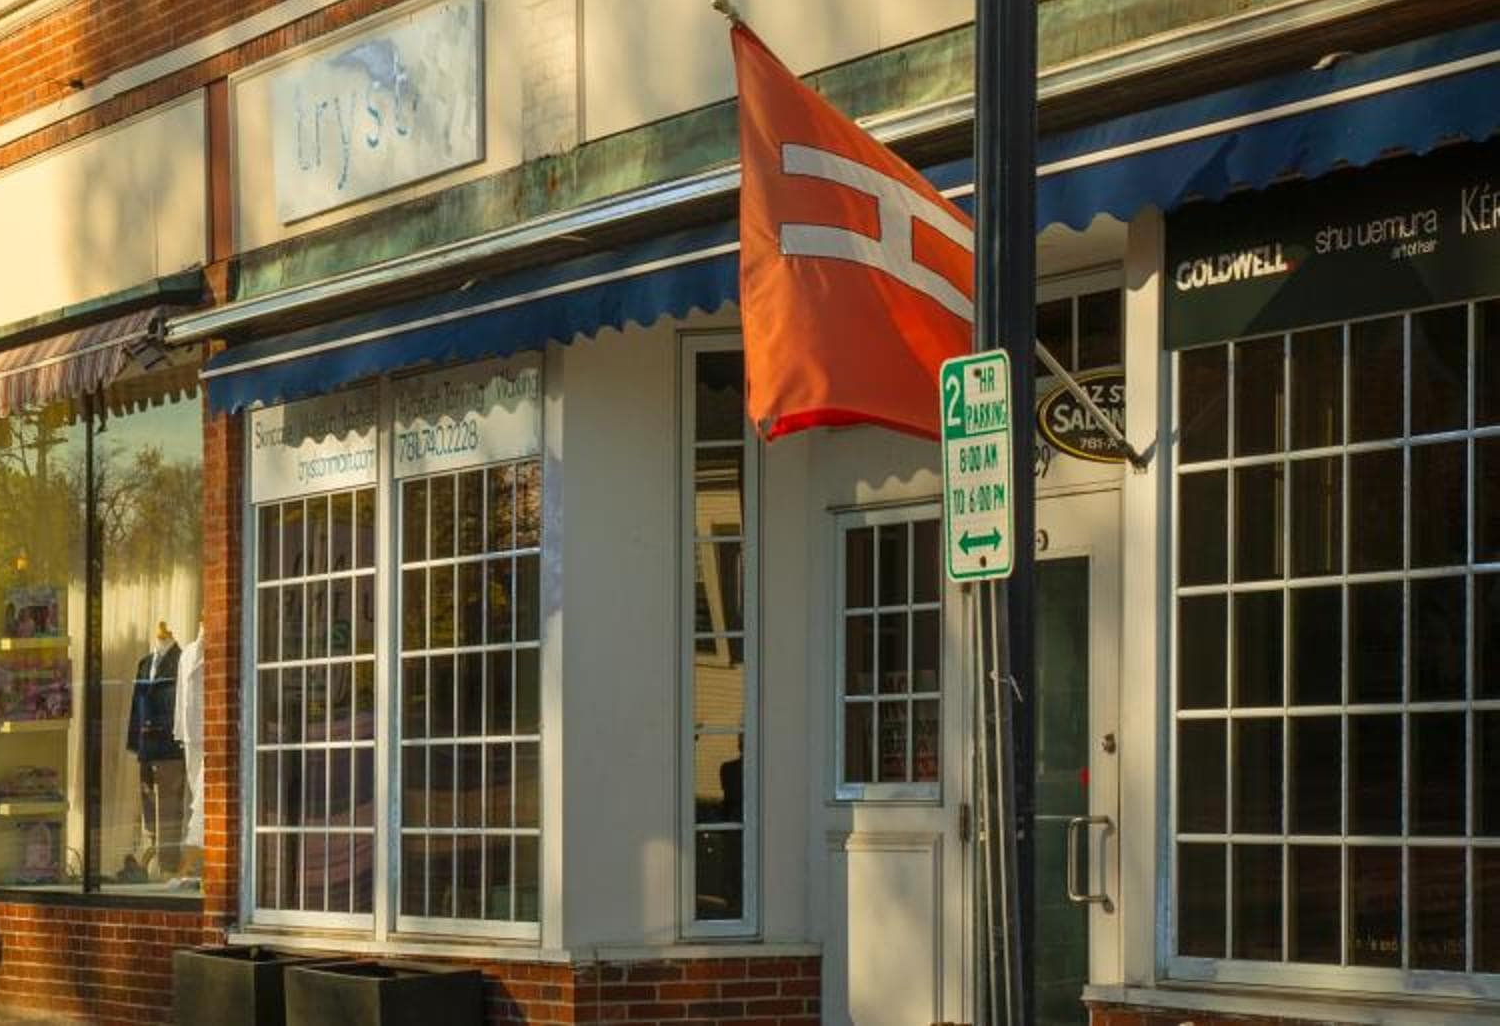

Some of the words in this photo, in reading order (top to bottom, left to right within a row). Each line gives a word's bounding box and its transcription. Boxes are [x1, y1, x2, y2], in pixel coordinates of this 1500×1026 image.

[1315, 224, 1351, 255] shu
[1358, 209, 1438, 247] uemura
[945, 375, 963, 427] 2
